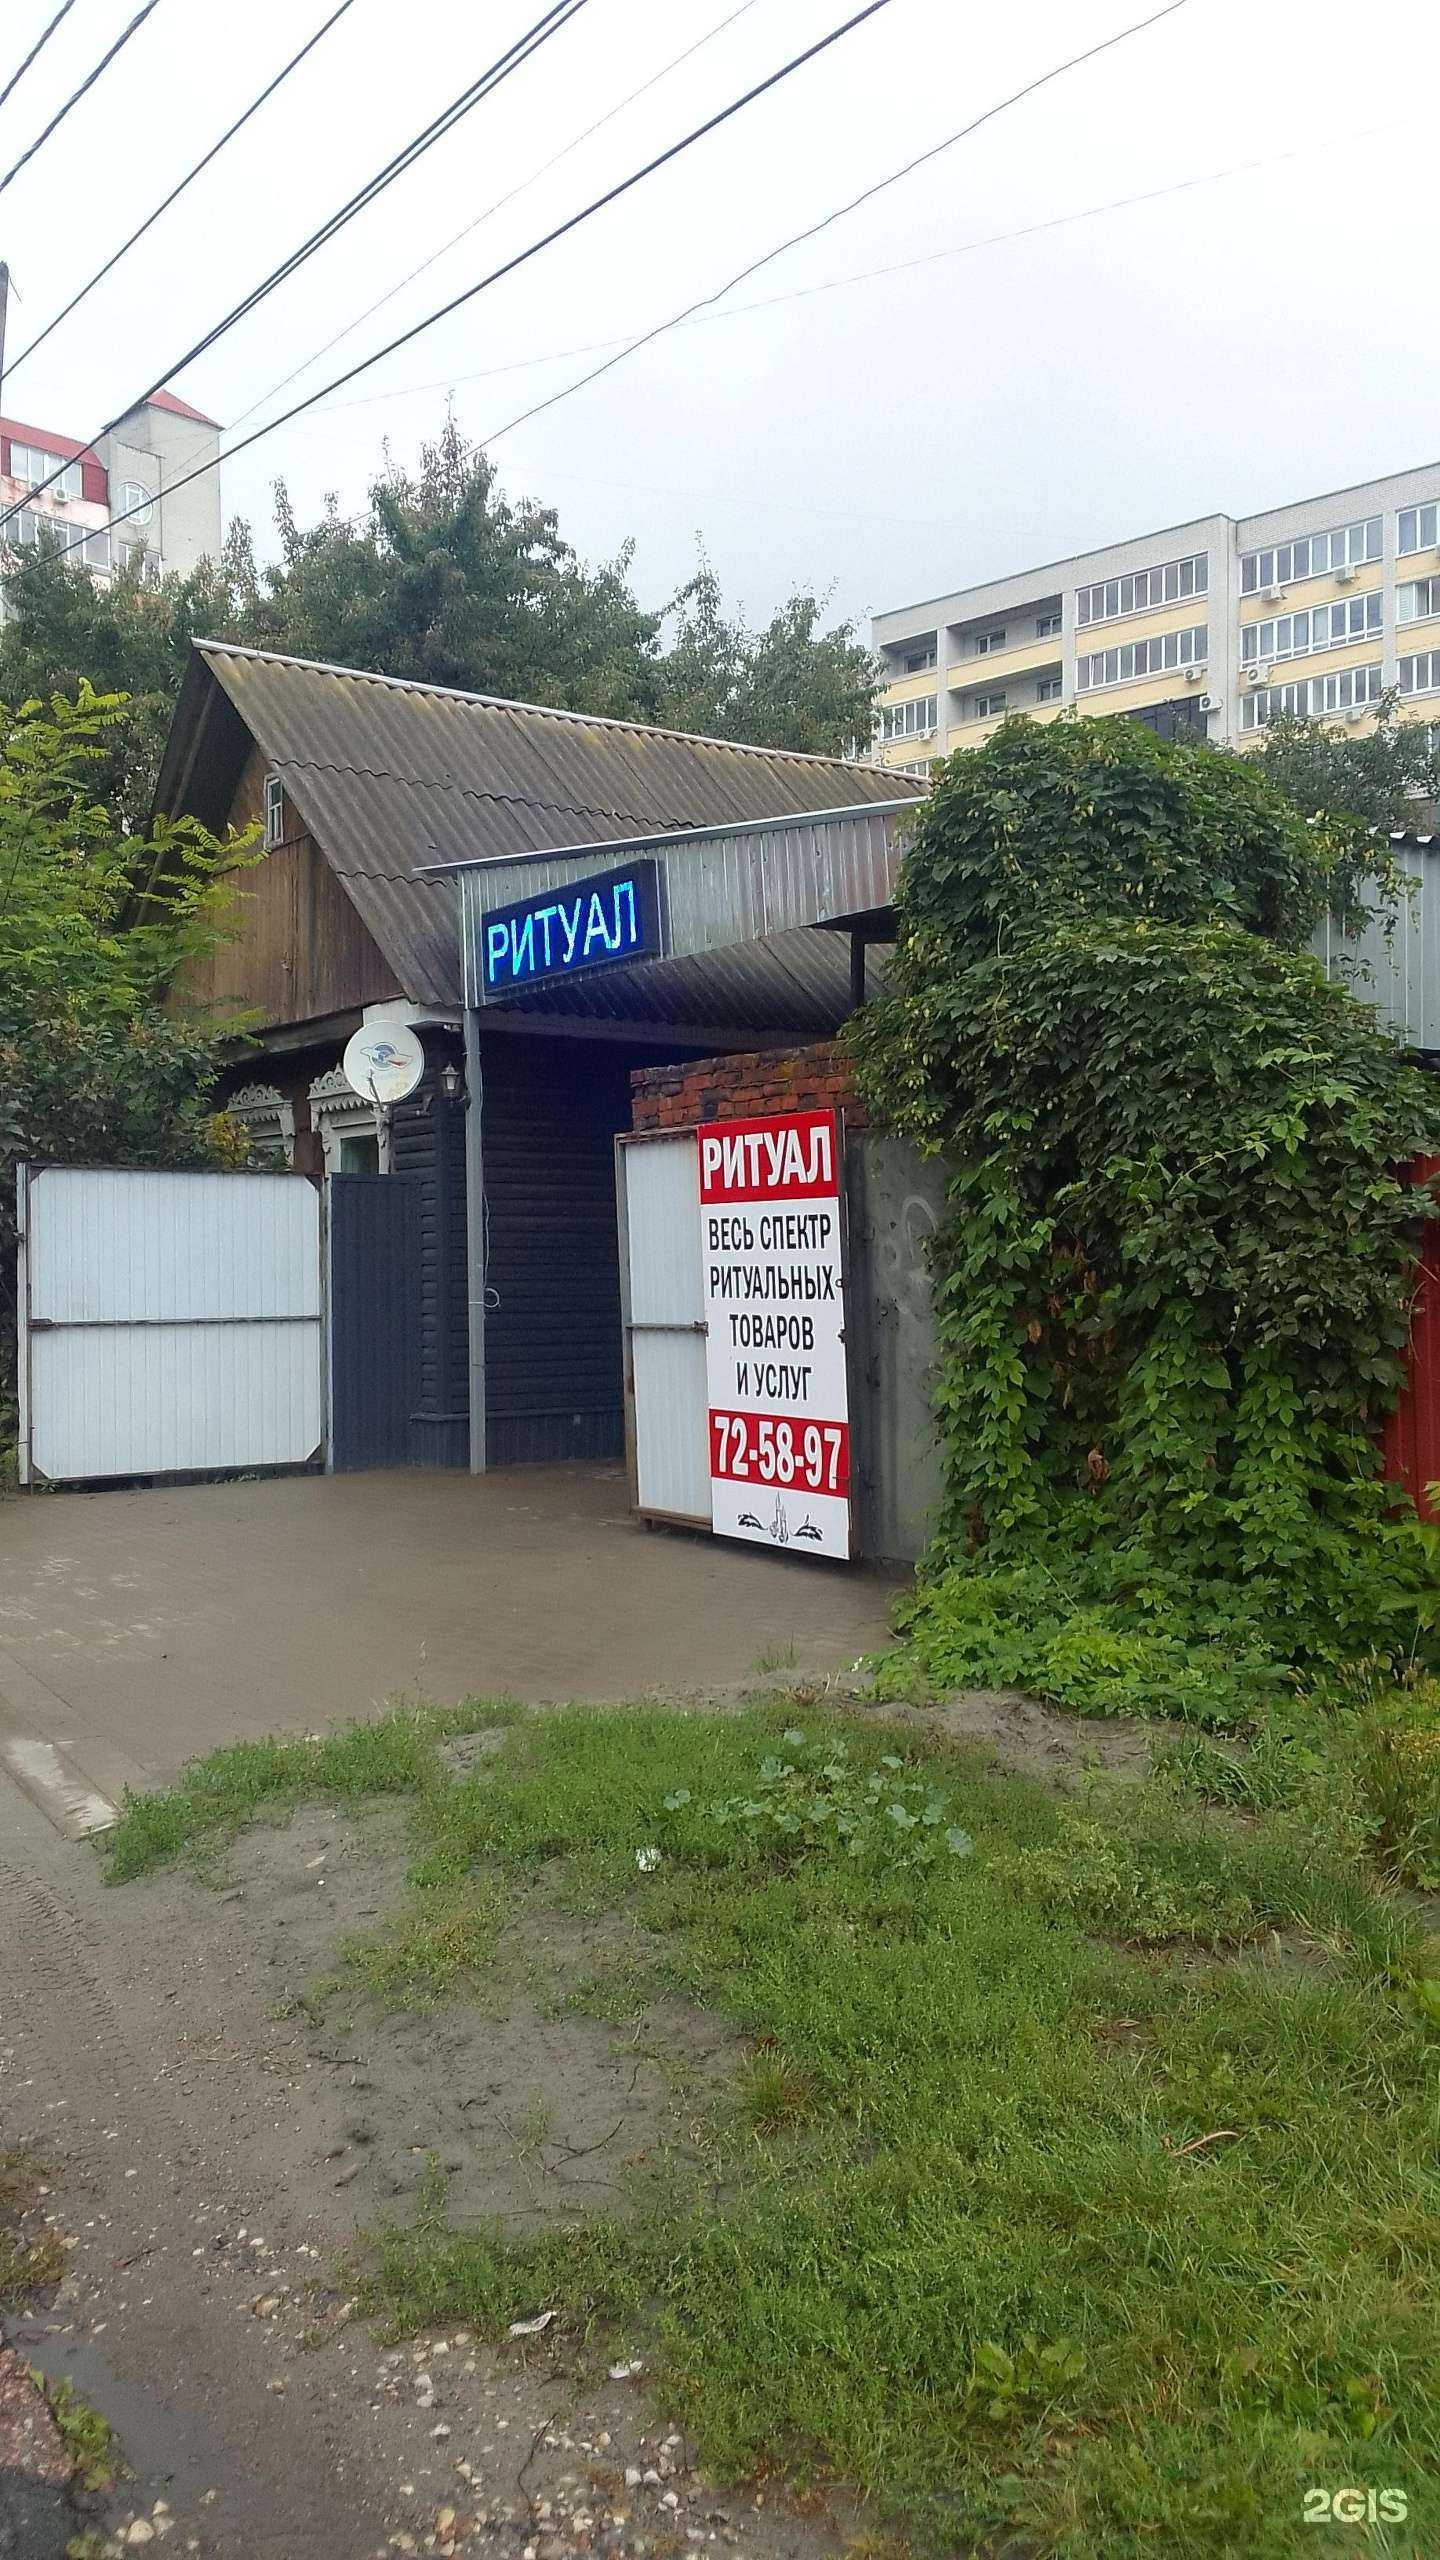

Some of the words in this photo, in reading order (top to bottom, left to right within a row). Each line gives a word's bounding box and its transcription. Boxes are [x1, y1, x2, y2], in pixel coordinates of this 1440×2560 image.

[487, 880, 637, 982] РИТУАЛ
[702, 1125, 833, 1190] РИТУАЛ
[708, 1216, 754, 1251] ВЕСЬ
[759, 1213, 831, 1250] СПЕКТР
[709, 1265, 836, 1300] РИТУАЛЬНЫХ
[729, 1313, 814, 1351] ТОВАРОВ
[736, 1361, 749, 1396] И
[754, 1362, 812, 1401] УСЛУГ
[714, 1415, 842, 1490] 72-58-97
